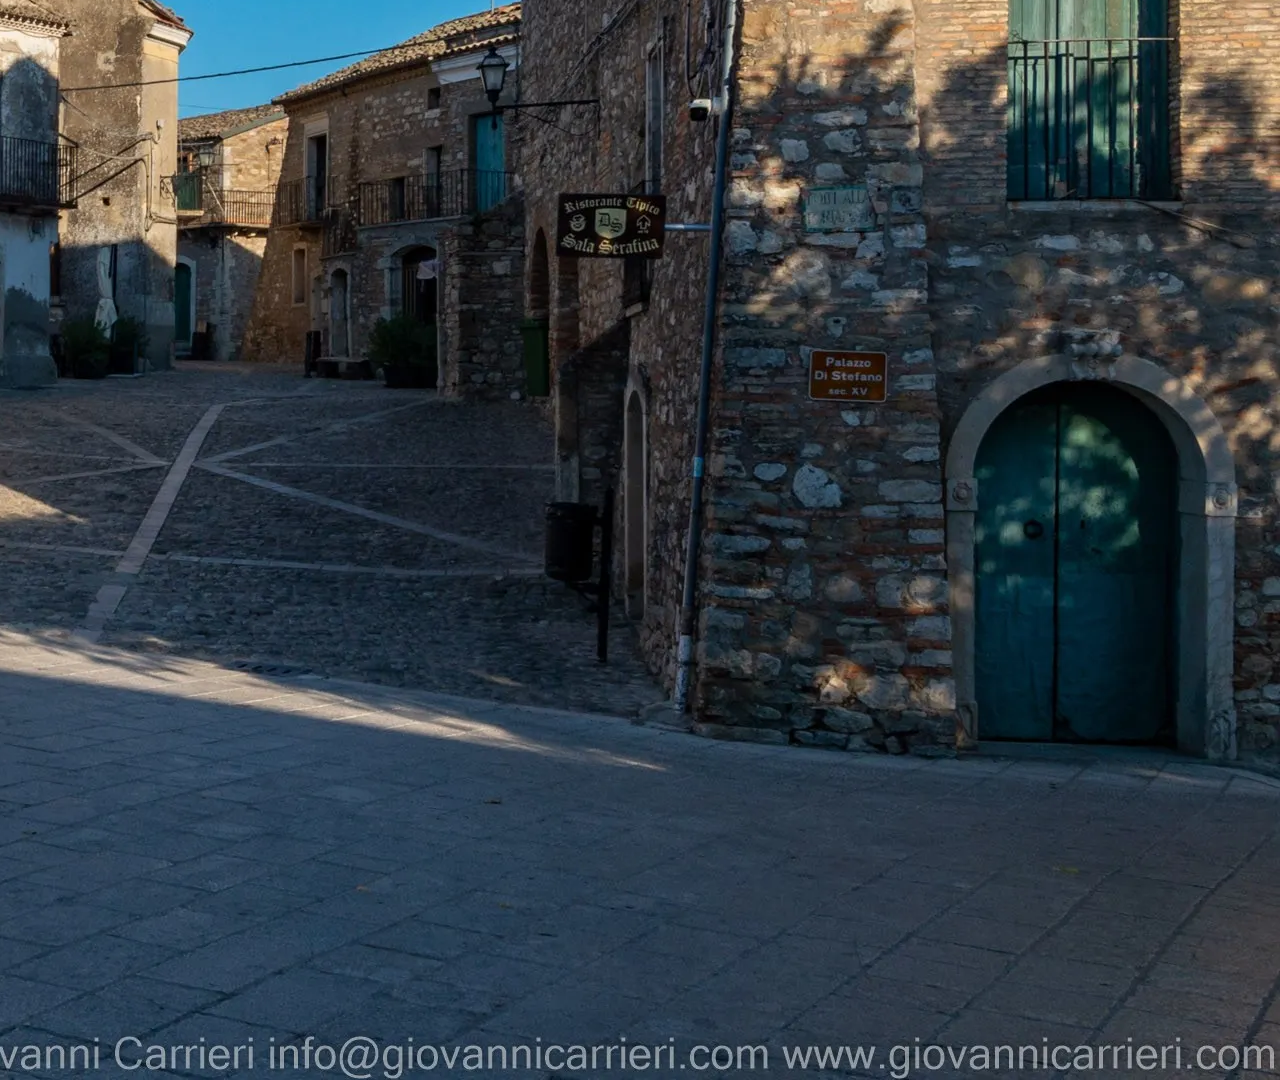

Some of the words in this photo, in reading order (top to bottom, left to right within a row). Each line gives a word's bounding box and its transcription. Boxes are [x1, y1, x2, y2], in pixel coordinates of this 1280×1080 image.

[564, 198, 622, 214] Ristorante
[626, 197, 660, 215] Tipico
[561, 233, 596, 253] Sala
[598, 238, 660, 255] Serafina
[826, 357, 872, 367] Palazzo
[814, 370, 828, 380] Di
[831, 370, 883, 382] Stefano
[851, 387, 868, 396] XV
